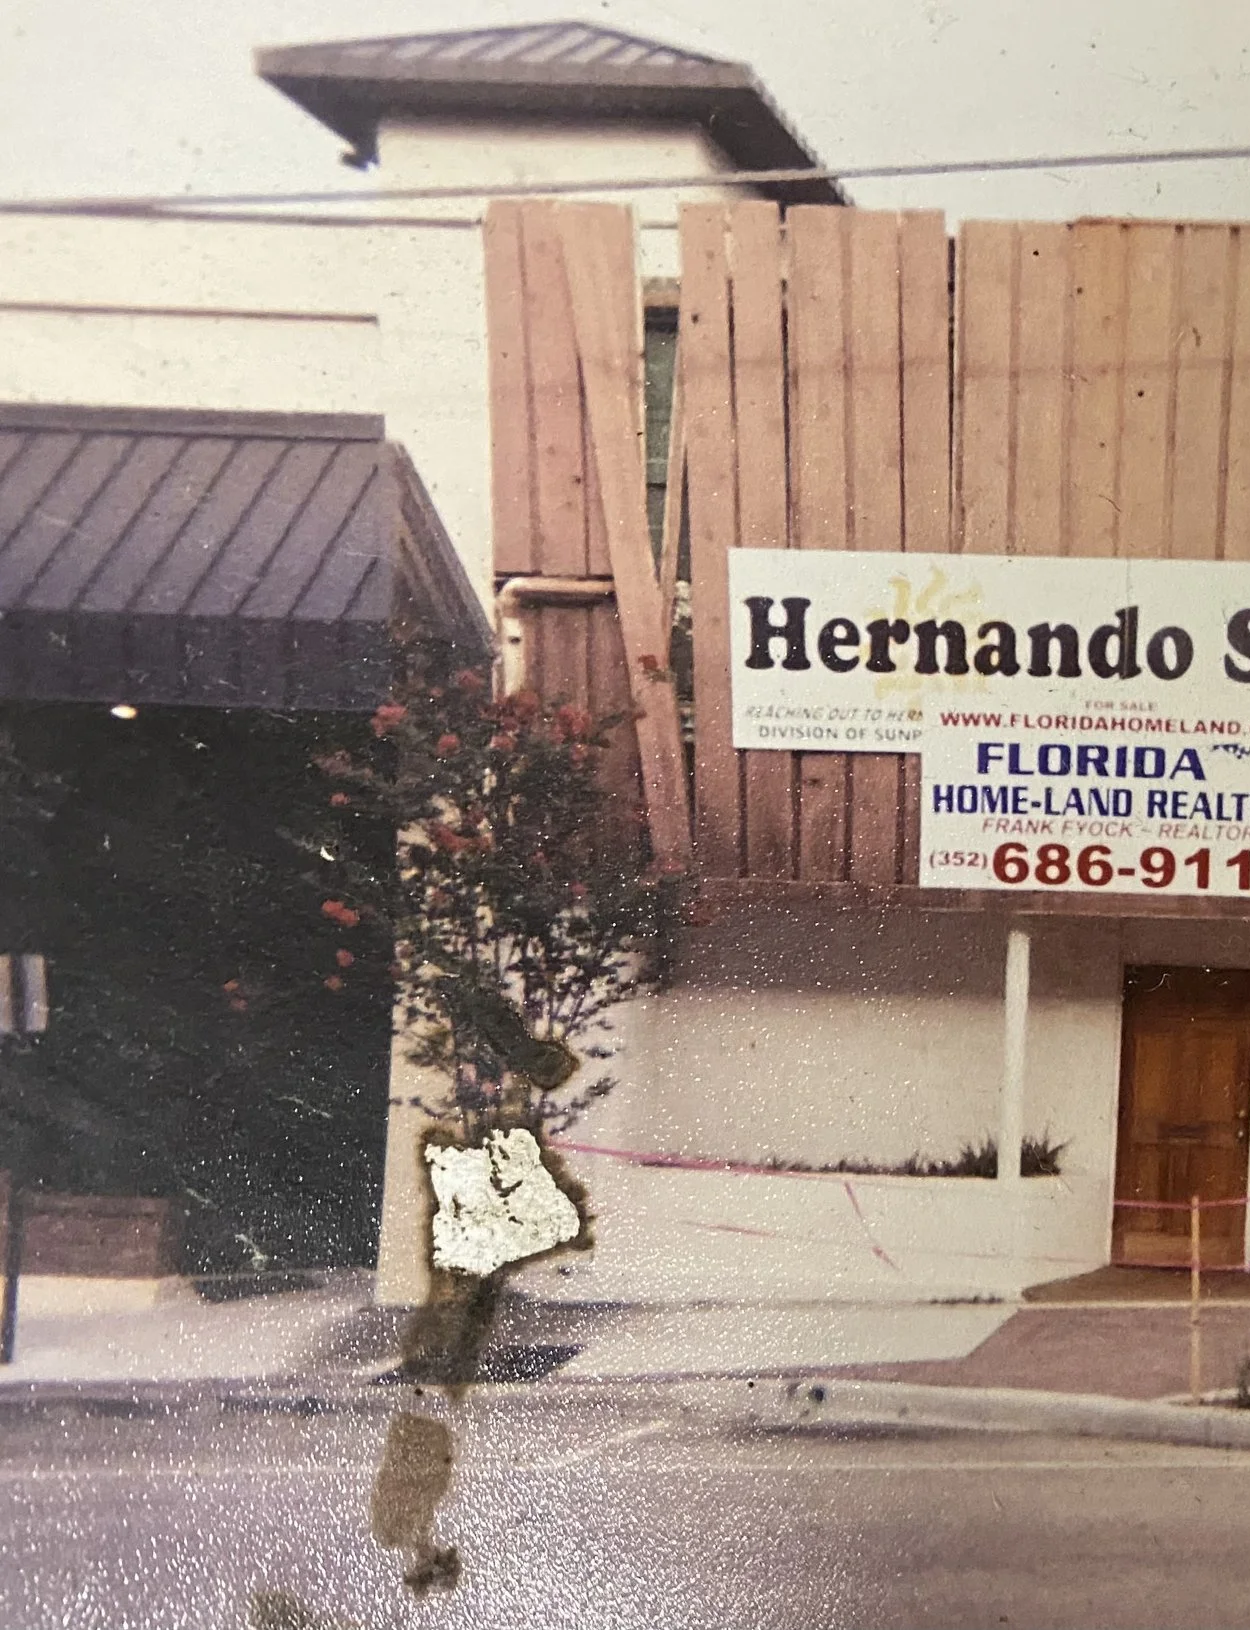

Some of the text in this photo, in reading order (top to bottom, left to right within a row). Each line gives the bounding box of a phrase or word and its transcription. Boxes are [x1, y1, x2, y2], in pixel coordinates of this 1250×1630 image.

[744, 596, 1194, 681] Hernando
[863, 707, 883, 721] TO
[1085, 700, 1158, 712] FOR SALE
[758, 724, 923, 742] DIVISION OF SUNP
[976, 741, 1207, 781] FLORIDA
[932, 784, 1133, 817] HOME-LAND
[981, 817, 1054, 835] FRANK
[1061, 818, 1133, 838] FYOCK
[929, 849, 988, 870] (352)
